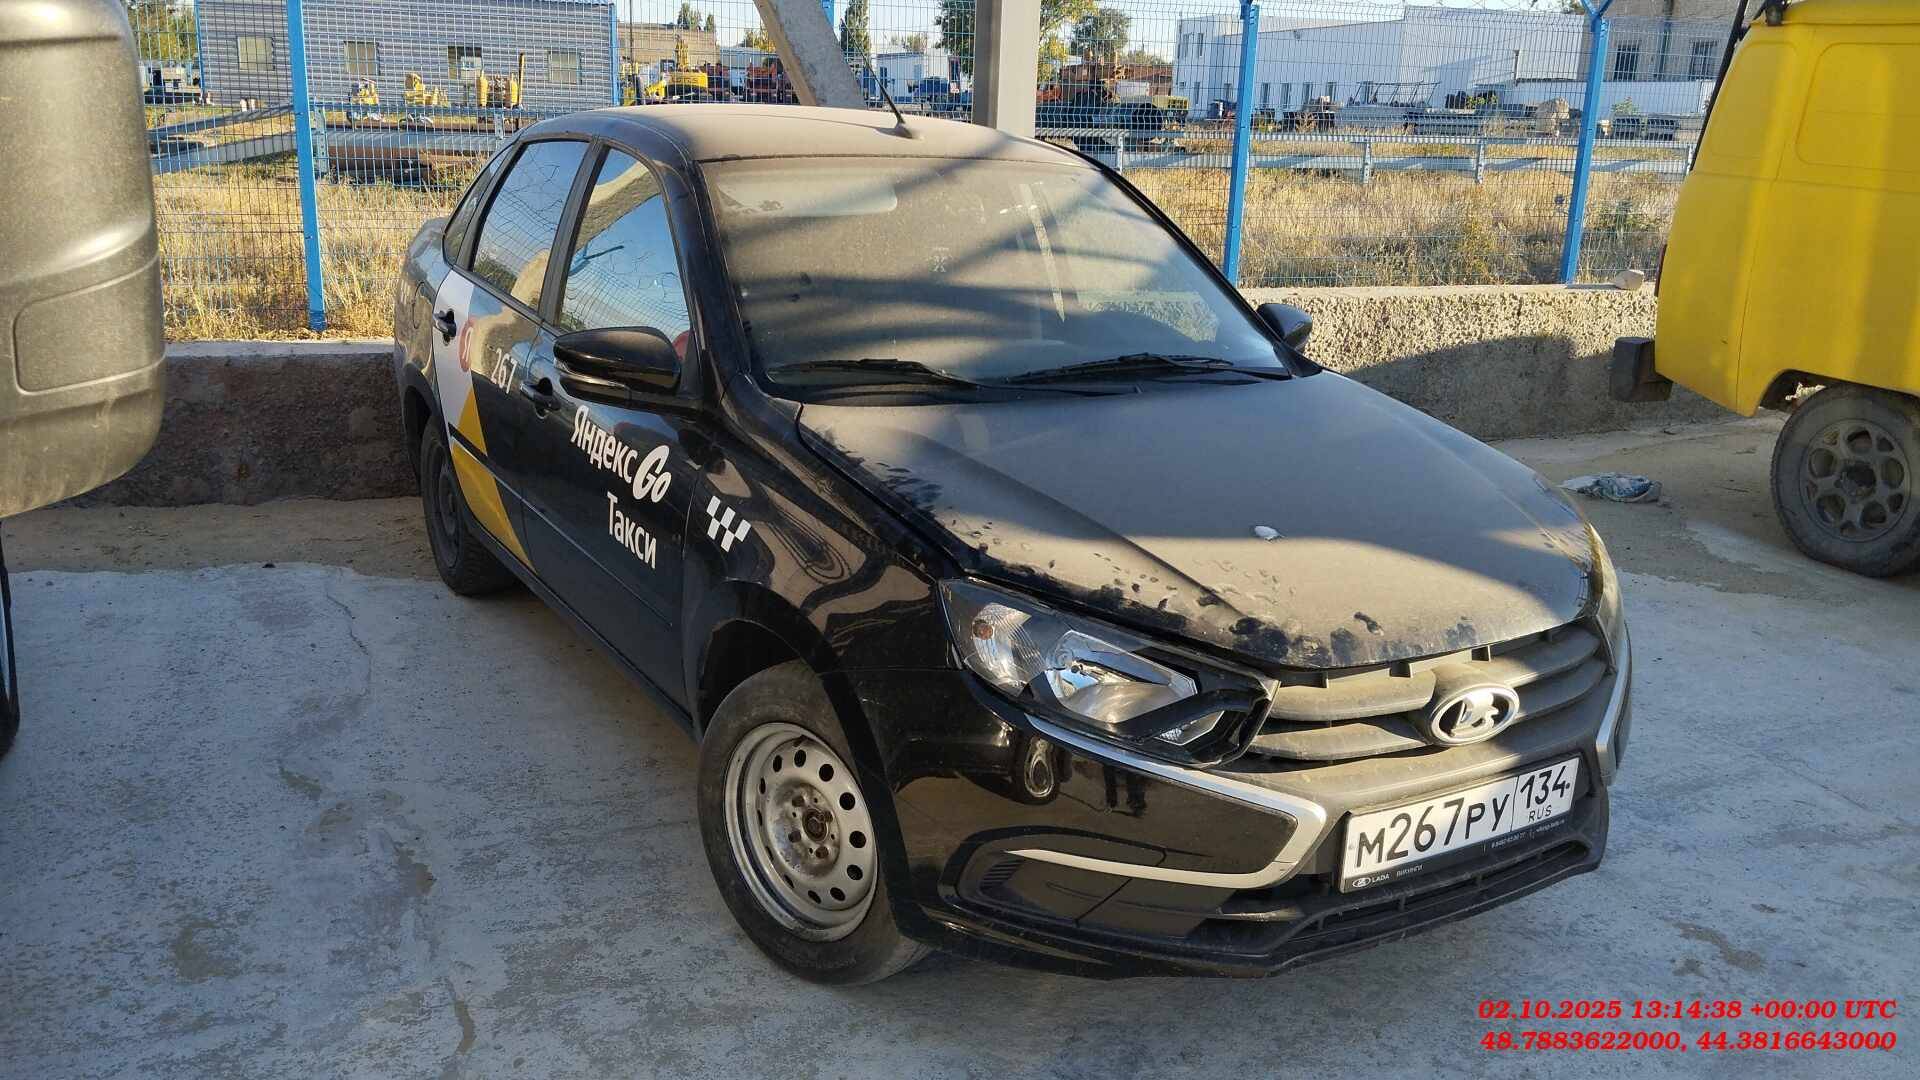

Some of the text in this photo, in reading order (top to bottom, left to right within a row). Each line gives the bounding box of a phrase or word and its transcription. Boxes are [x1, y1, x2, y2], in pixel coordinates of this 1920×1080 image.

[490, 347, 518, 394] 267
[570, 404, 672, 504] Яндекс Go
[606, 491, 657, 569] Такси
[1520, 765, 1567, 810] 134
[1528, 804, 1553, 823] RUS
[1371, 873, 1391, 883] LADA
